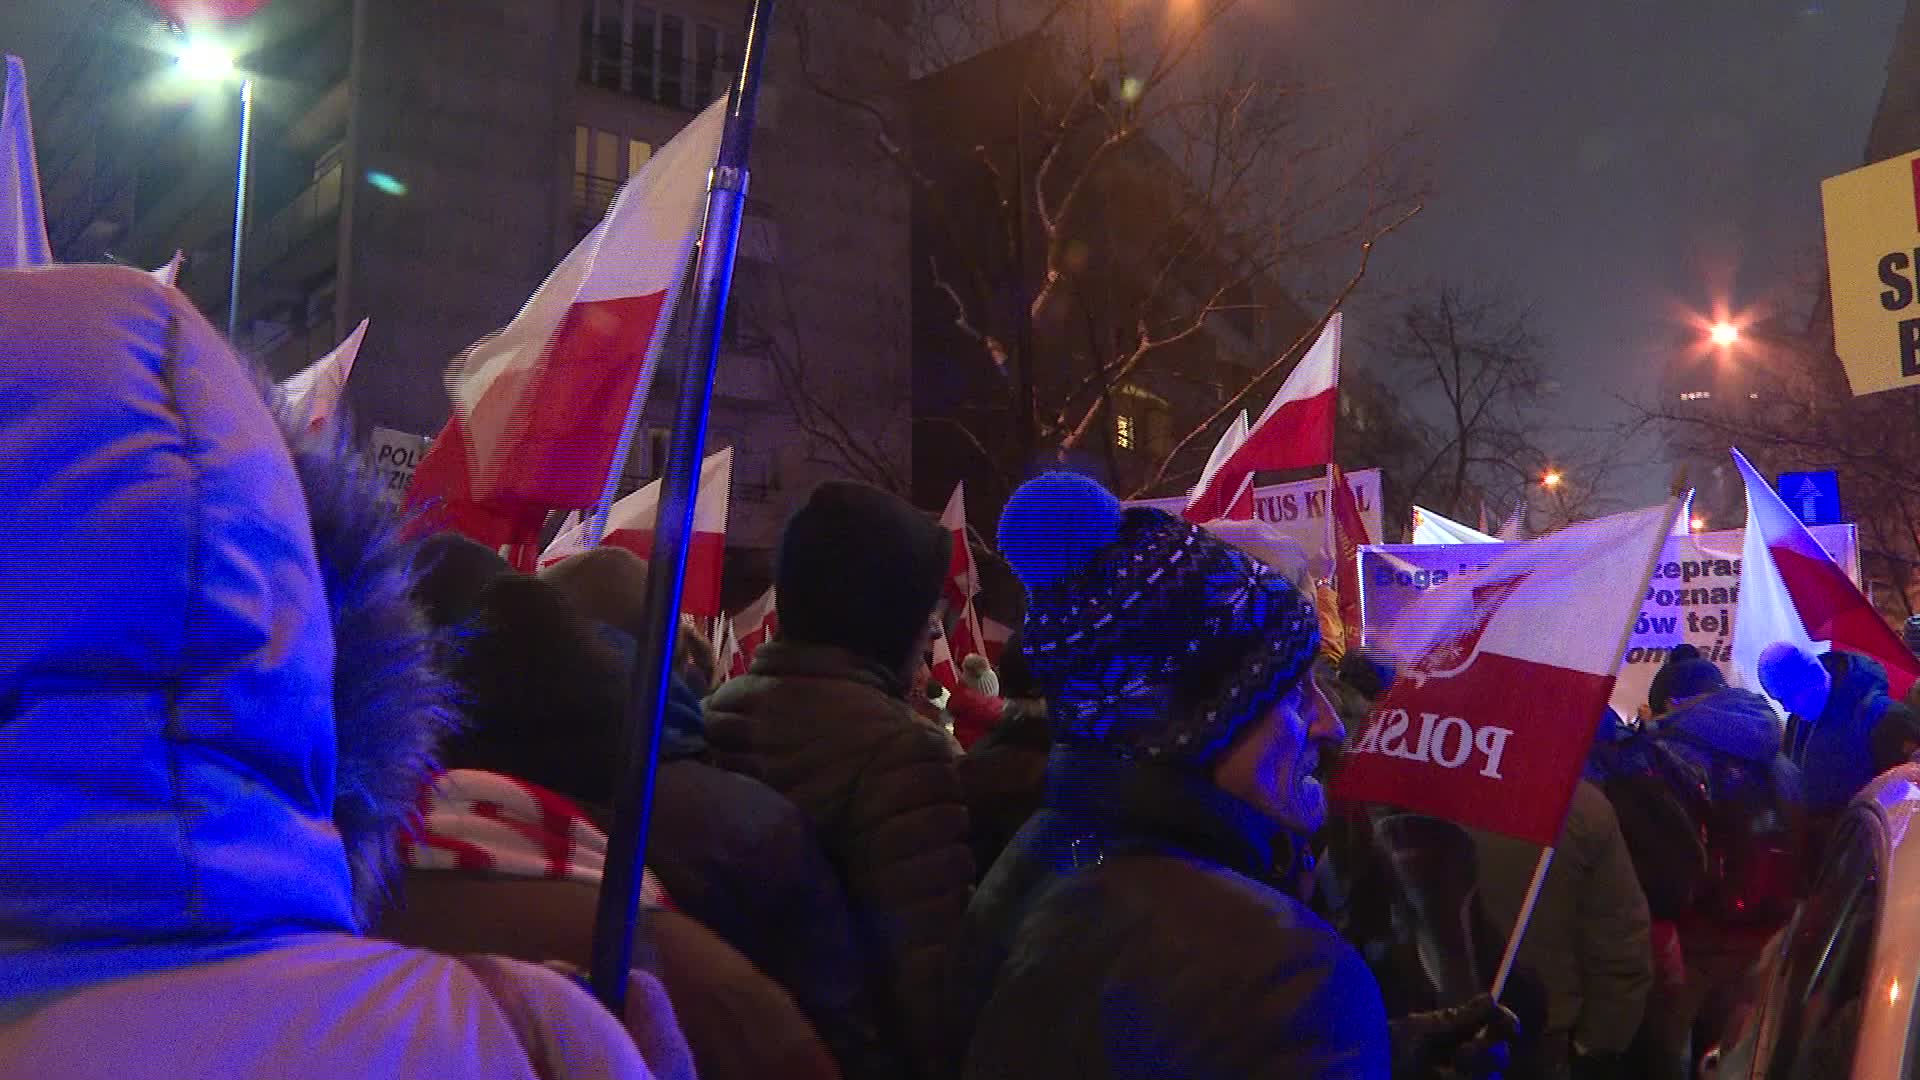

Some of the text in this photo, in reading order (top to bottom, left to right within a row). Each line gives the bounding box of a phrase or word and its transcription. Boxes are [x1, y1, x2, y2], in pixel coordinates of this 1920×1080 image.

[1878, 247, 1920, 312] S
[378, 444, 422, 468] POL
[1254, 493, 1299, 522] TUS
[1652, 559, 1740, 582] zepras
[1633, 610, 1729, 636] ów tej
